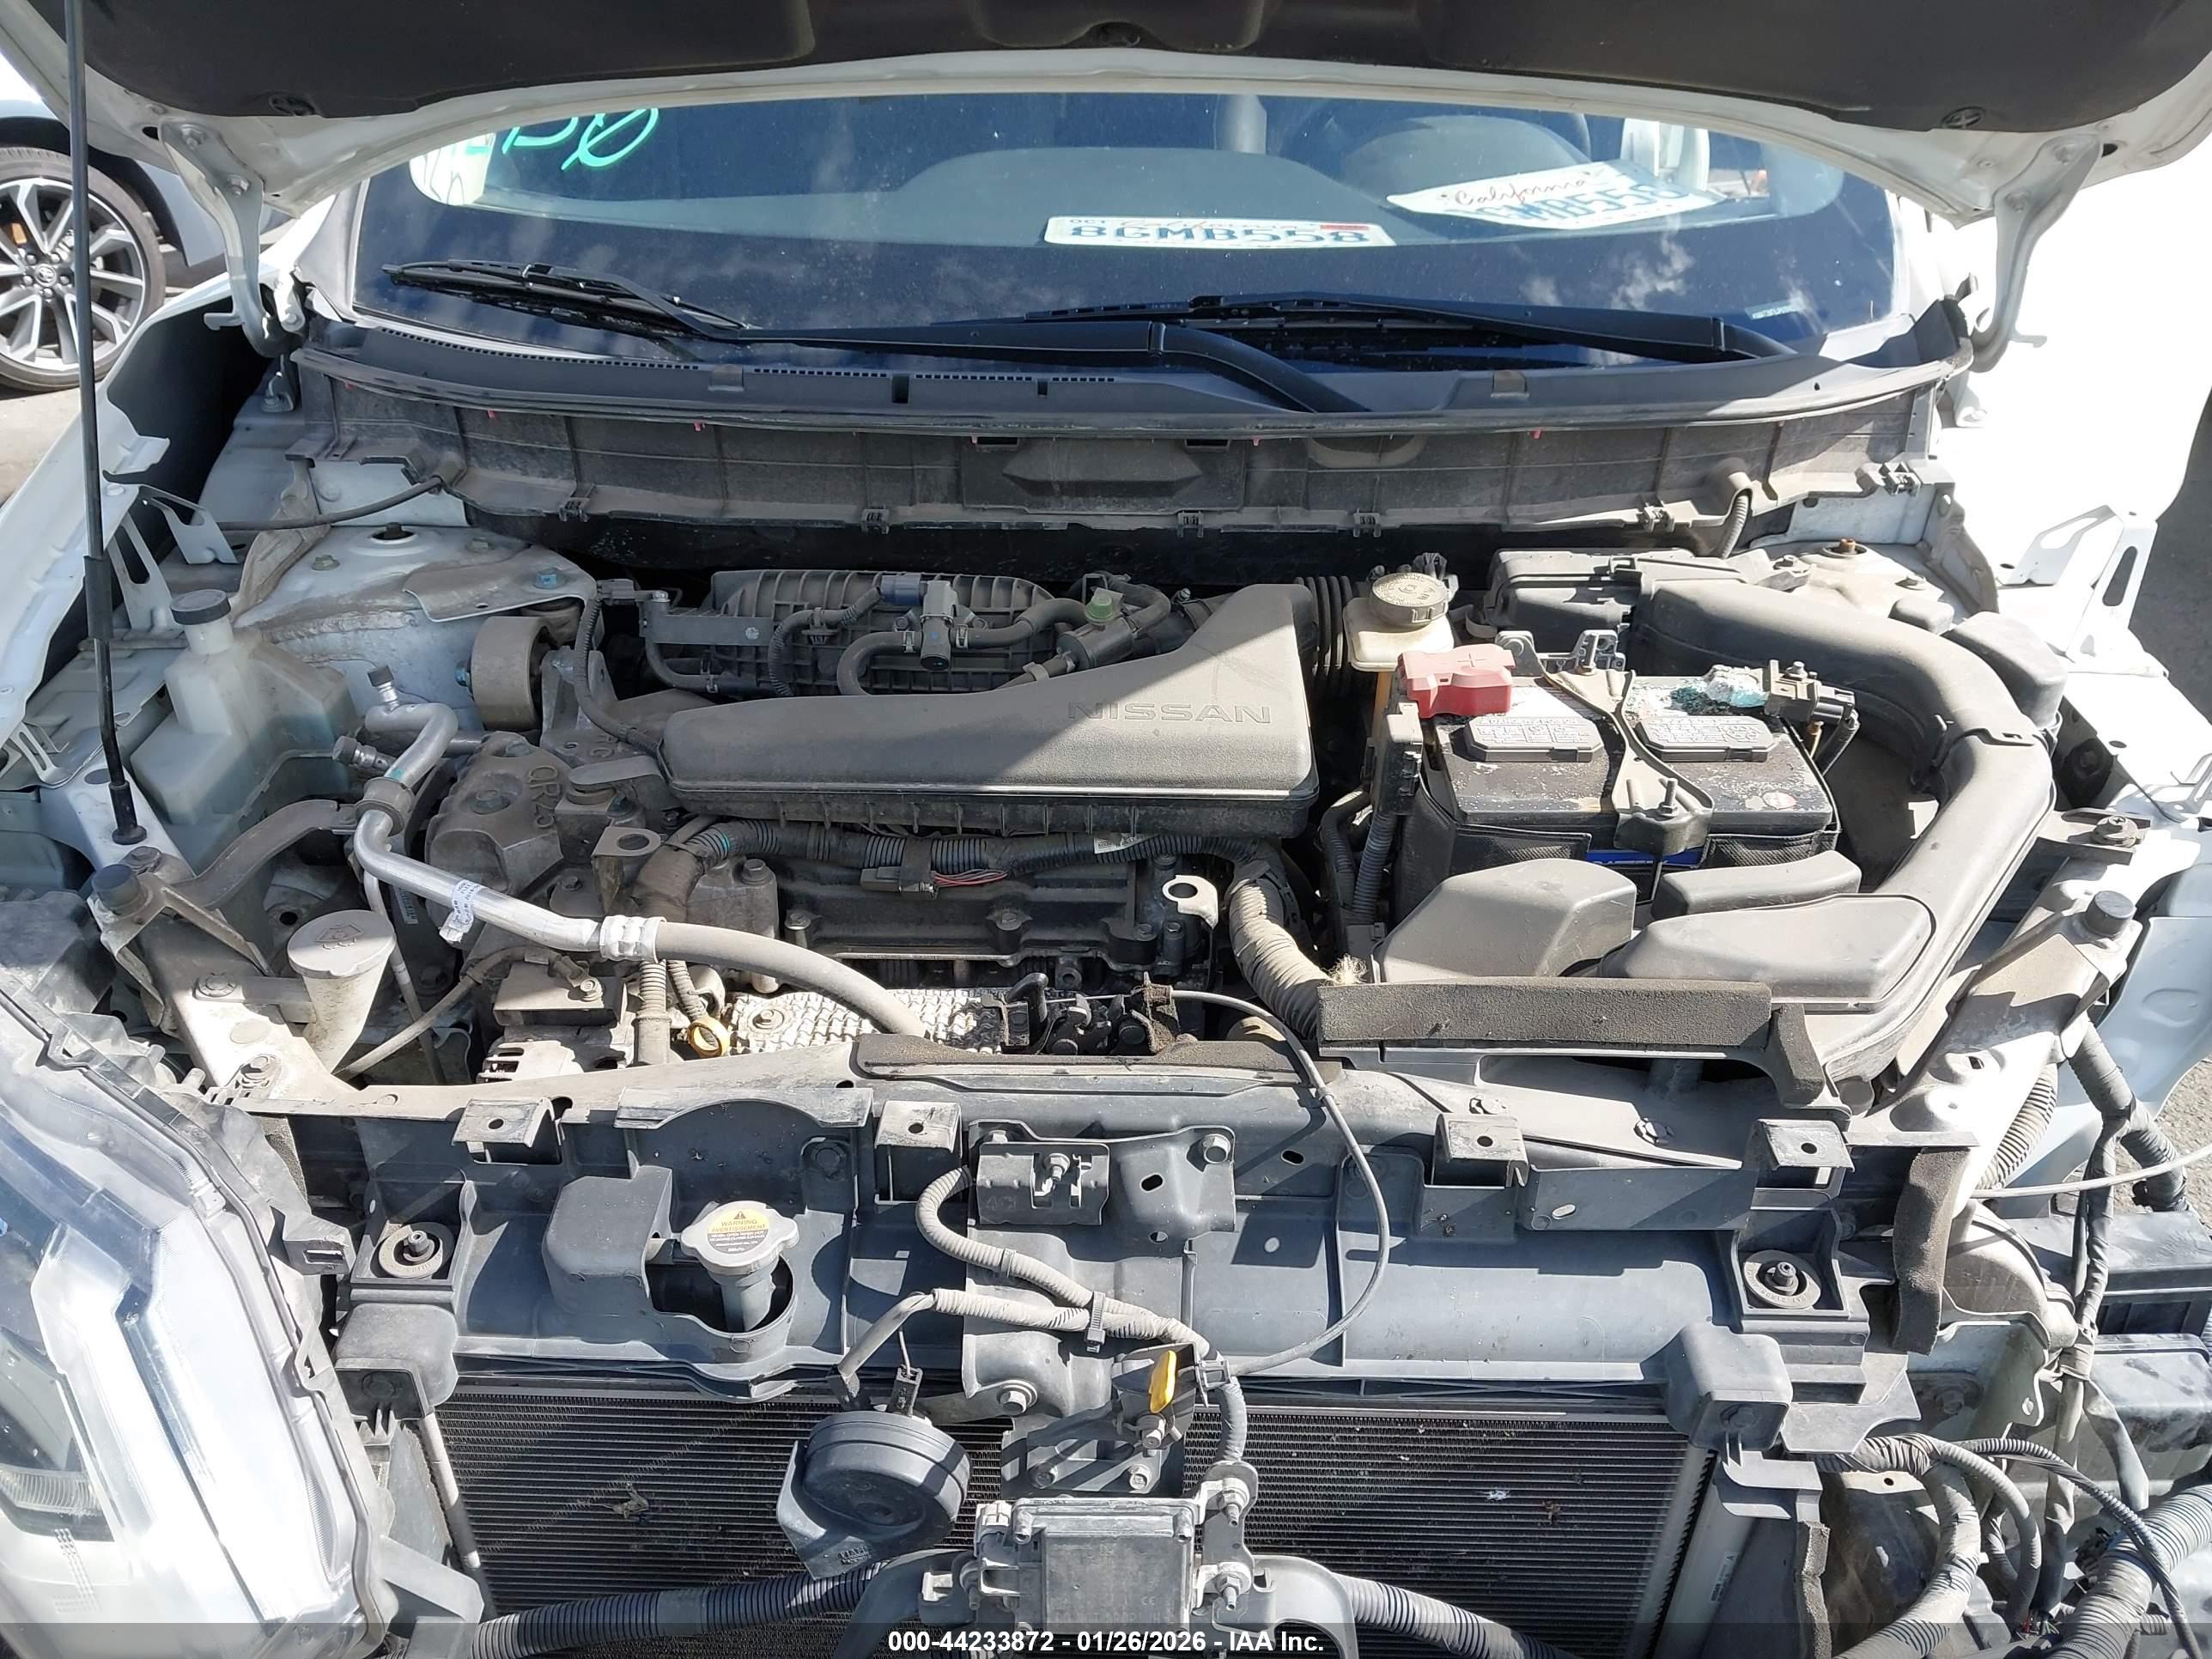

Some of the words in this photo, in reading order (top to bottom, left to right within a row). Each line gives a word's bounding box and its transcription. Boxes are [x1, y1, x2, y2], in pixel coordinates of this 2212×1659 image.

[1454, 179, 1585, 205] California
[1071, 226, 1370, 243] 8GMB558
[1067, 702, 1272, 724] NISSAN
[720, 1218, 758, 1227] WARNING
